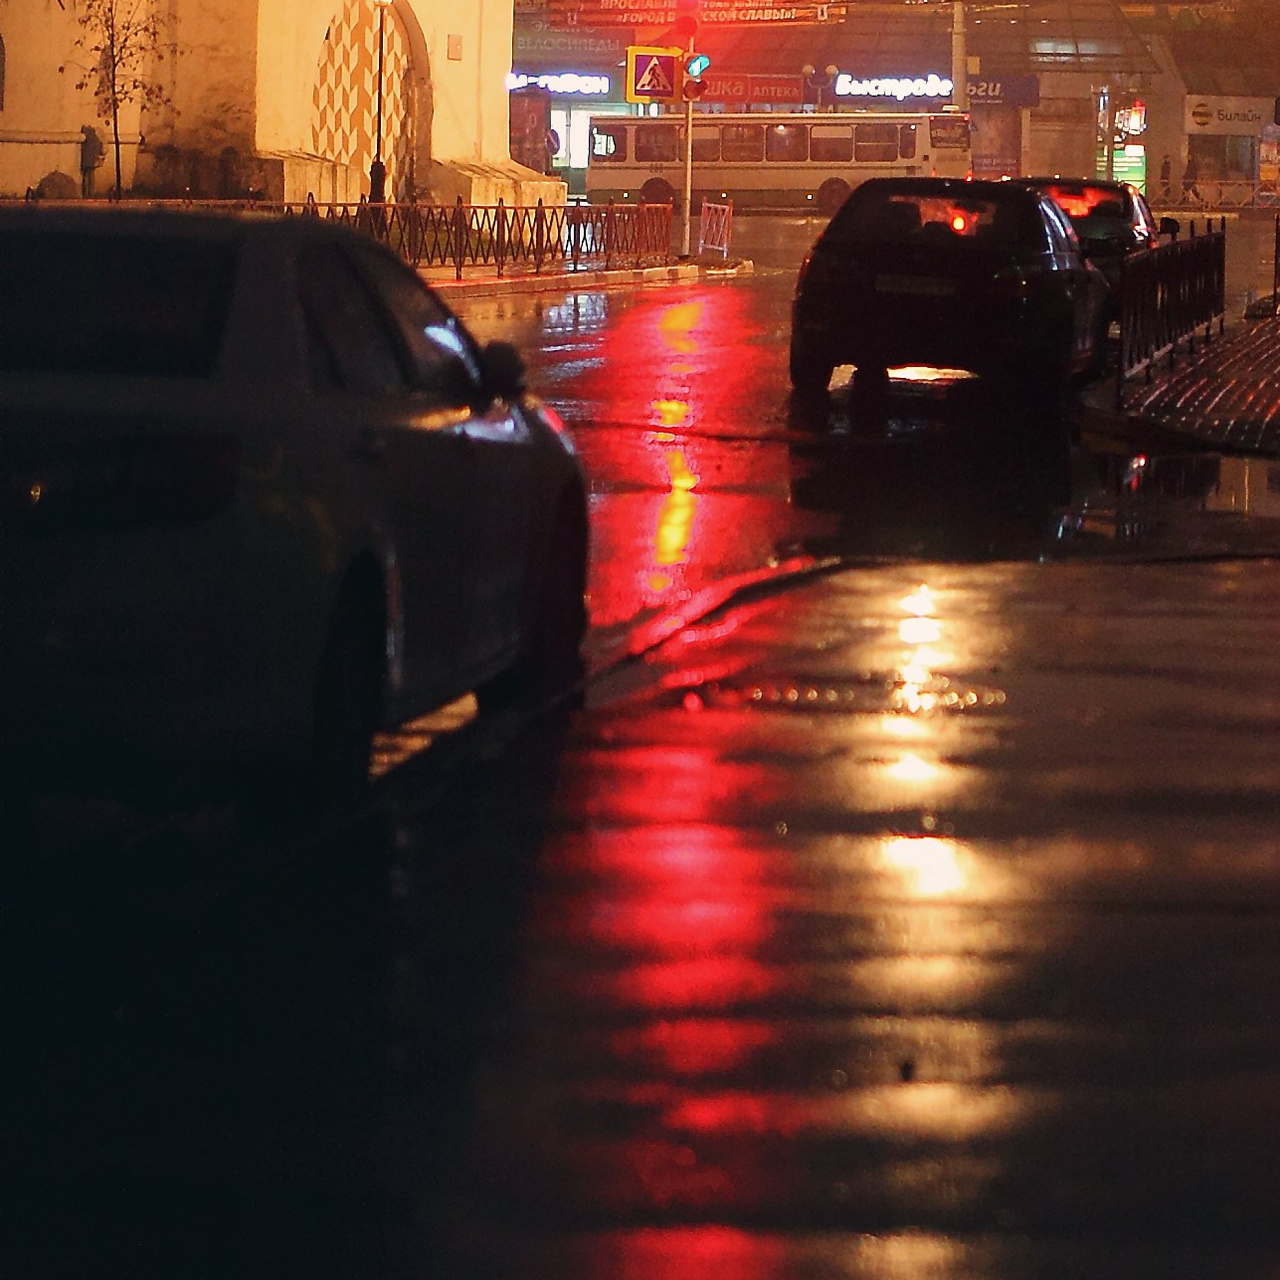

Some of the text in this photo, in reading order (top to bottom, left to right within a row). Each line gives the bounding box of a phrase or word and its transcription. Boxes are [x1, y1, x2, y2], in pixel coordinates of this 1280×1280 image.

[518, 37, 620, 52] ВЕЛОСИПЕДЫ
[753, 86, 798, 97] АПТЕКА
[1217, 109, 1261, 122] билайн
